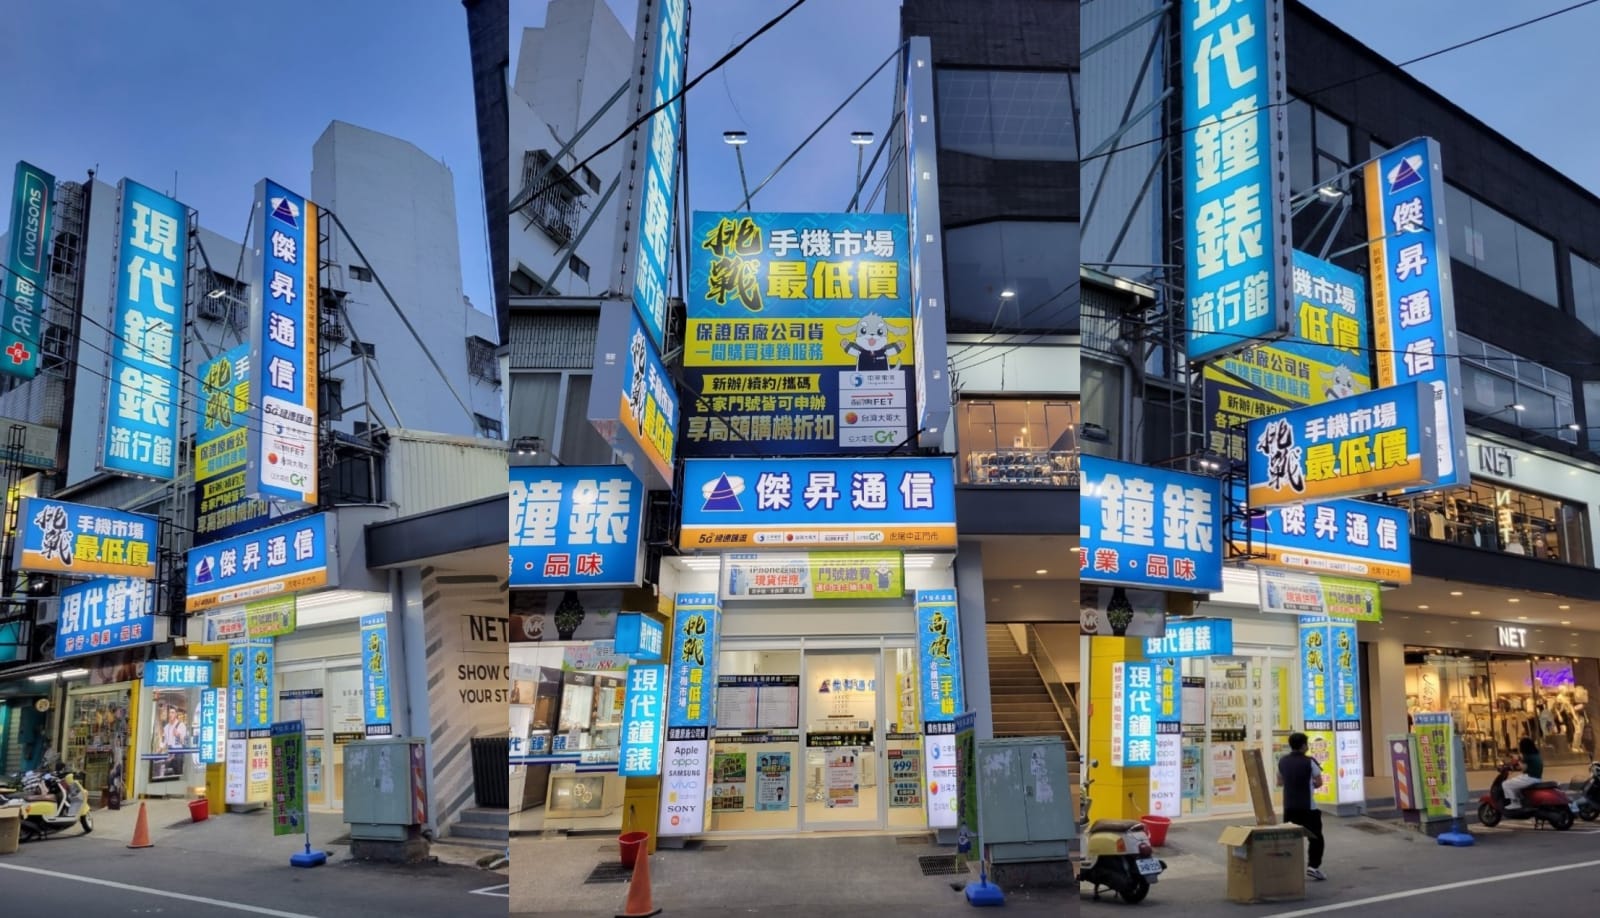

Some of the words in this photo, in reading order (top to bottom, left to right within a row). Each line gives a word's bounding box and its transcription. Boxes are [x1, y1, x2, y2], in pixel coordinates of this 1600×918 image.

[24, 189, 41, 257] watsons
[769, 229, 895, 258] 手機市場
[702, 216, 764, 312] 挑戰
[766, 260, 900, 300] 最低價
[1393, 197, 1435, 376] 傑昇通信
[118, 200, 178, 428] 現代鐘錶
[267, 230, 298, 393] 傑昇通信
[1191, 271, 1270, 341] 流行館
[696, 322, 825, 342] 保證原廠公司貨
[1299, 302, 1361, 356] 低價
[696, 343, 825, 362] 一間購買連鎖服務
[630, 327, 646, 439] 挑戰
[649, 362, 673, 426] 手機市場
[695, 395, 826, 413] 各家門號皆可申辦
[712, 376, 811, 392] 新辦/續約/攜碼
[644, 392, 674, 466] 最低價
[687, 414, 835, 442] 享高額購機折扣
[1305, 402, 1397, 443] 手機市場
[109, 425, 172, 468] 流行館
[1257, 418, 1306, 493] 挑戰
[1304, 428, 1410, 482] 最低價
[1479, 444, 1516, 479] NET
[509, 479, 632, 547] 鐘錶
[755, 471, 935, 511] 傑昇通信
[1080, 470, 1213, 553] 鐘錶
[34, 505, 73, 567] 挑戰
[77, 515, 144, 539] 手機市場
[1280, 503, 1399, 551] 傑昇通信
[75, 534, 149, 567] 最低價
[219, 528, 314, 579] 傑昇通信
[468, 615, 509, 642] NET
[682, 613, 706, 666] 挑戰
[1497, 626, 1527, 648] NET
[157, 665, 209, 683] 現代鐘錶
[458, 664, 500, 681] SHOW
[459, 689, 492, 703] YOUR
[1128, 666, 1152, 761] 現代鐘錶
[202, 690, 216, 760] 現代鐘錶
[625, 669, 658, 771] 現代鐘錶
[668, 769, 701, 777] SAMSUNG
[674, 746, 699, 756] Apple
[667, 805, 696, 813] SONY
